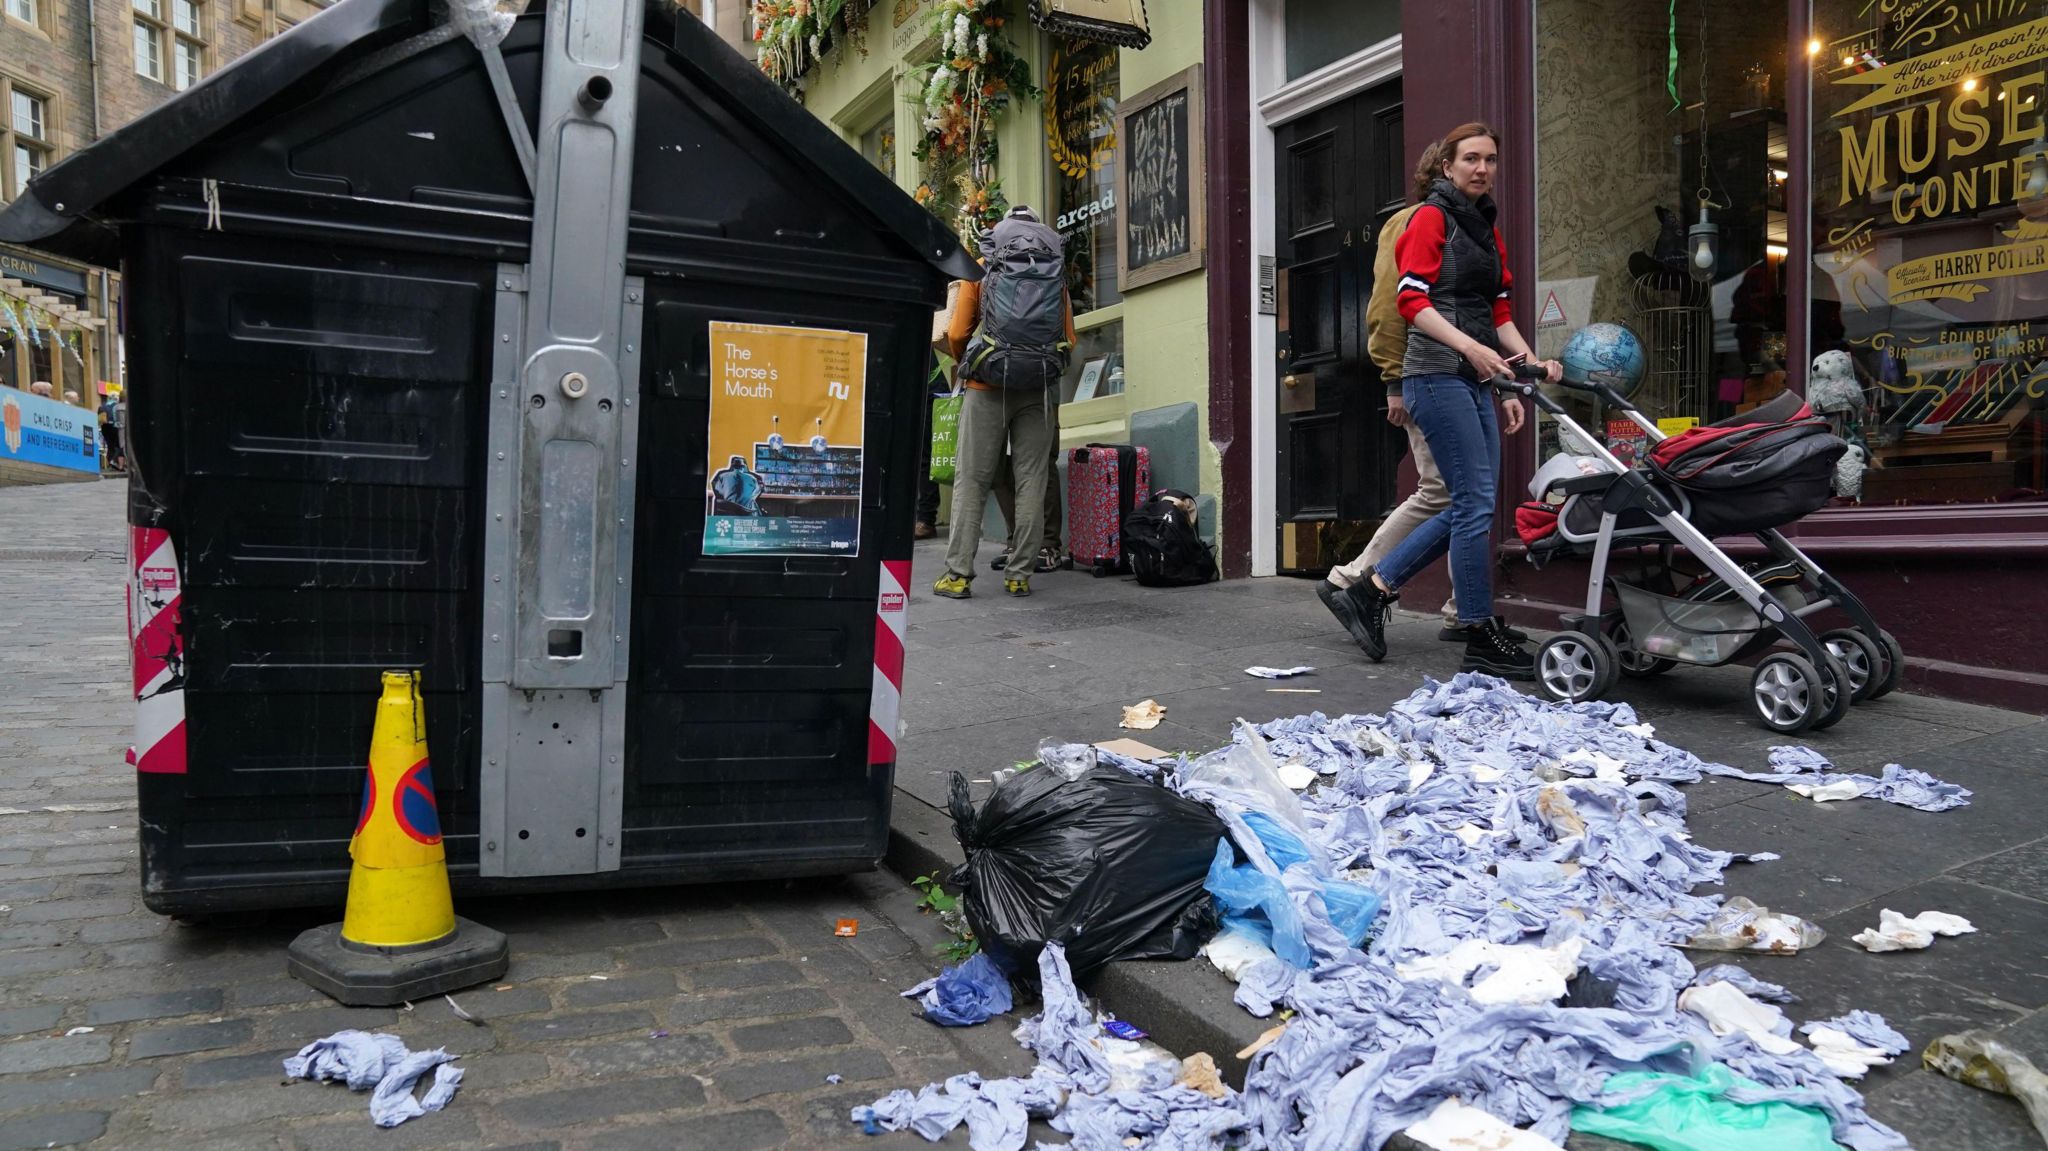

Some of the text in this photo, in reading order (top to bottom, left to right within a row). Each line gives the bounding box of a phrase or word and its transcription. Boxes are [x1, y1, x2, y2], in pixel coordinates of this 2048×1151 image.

[1837, 39, 1878, 62] WELL
[1894, 57, 1942, 79] Allow
[1969, 45, 1984, 56] to
[1066, 64, 1079, 90] 15
[1895, 43, 2048, 95] in the right directio
[1839, 70, 2045, 208] MUSE
[1892, 150, 2048, 224] CONTE
[1056, 189, 1117, 230] arcad
[1150, 195, 1165, 221] IN
[1129, 215, 1186, 261] TOWN
[1833, 229, 1872, 263] BUILT
[1934, 244, 2045, 279] HARRY POTTER
[1939, 321, 2030, 344] EDINBURGH
[724, 343, 752, 360] The
[1972, 345, 1991, 360] OF
[1996, 336, 2047, 358] HARRY
[725, 380, 773, 399] Mouth
[54, 417, 73, 432] CRISP
[27, 432, 40, 446] AND
[42, 435, 79, 454] REFRESHING
